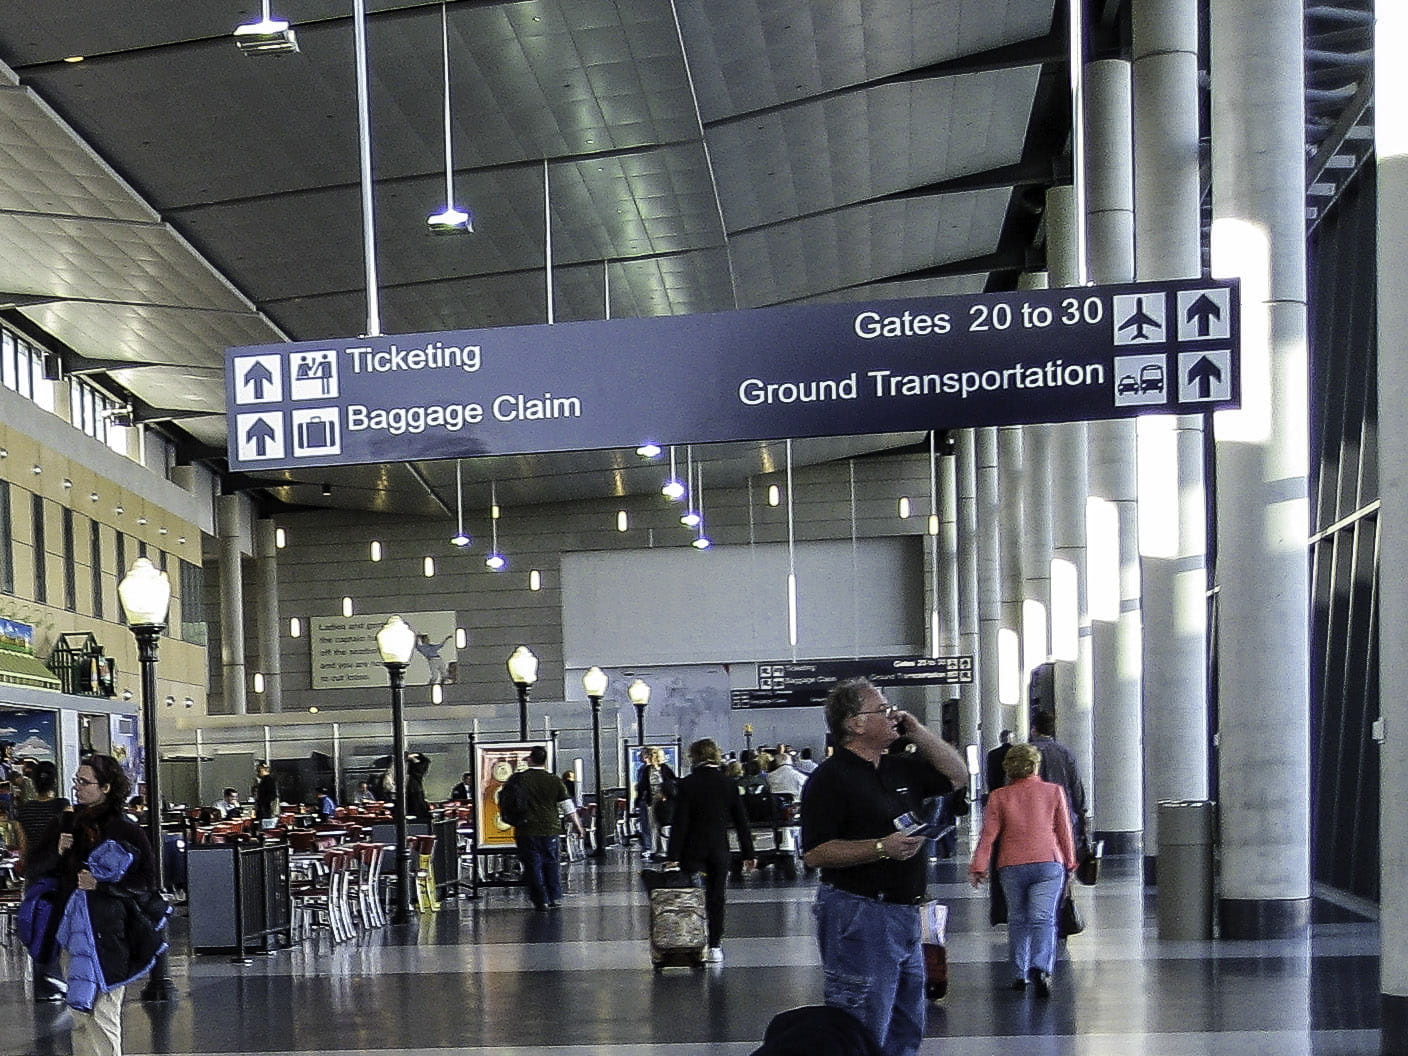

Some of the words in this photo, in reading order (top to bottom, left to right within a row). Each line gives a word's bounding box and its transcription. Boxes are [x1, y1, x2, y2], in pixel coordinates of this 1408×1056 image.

[854, 311, 952, 339] Gates
[968, 303, 1012, 331] 20
[1021, 302, 1053, 328] to
[1061, 297, 1104, 325] 30
[345, 342, 482, 374] Ticketing
[738, 373, 858, 406] Ground
[867, 359, 1105, 399] Transportation
[346, 402, 485, 435] Baggage
[492, 393, 582, 421] Claim
